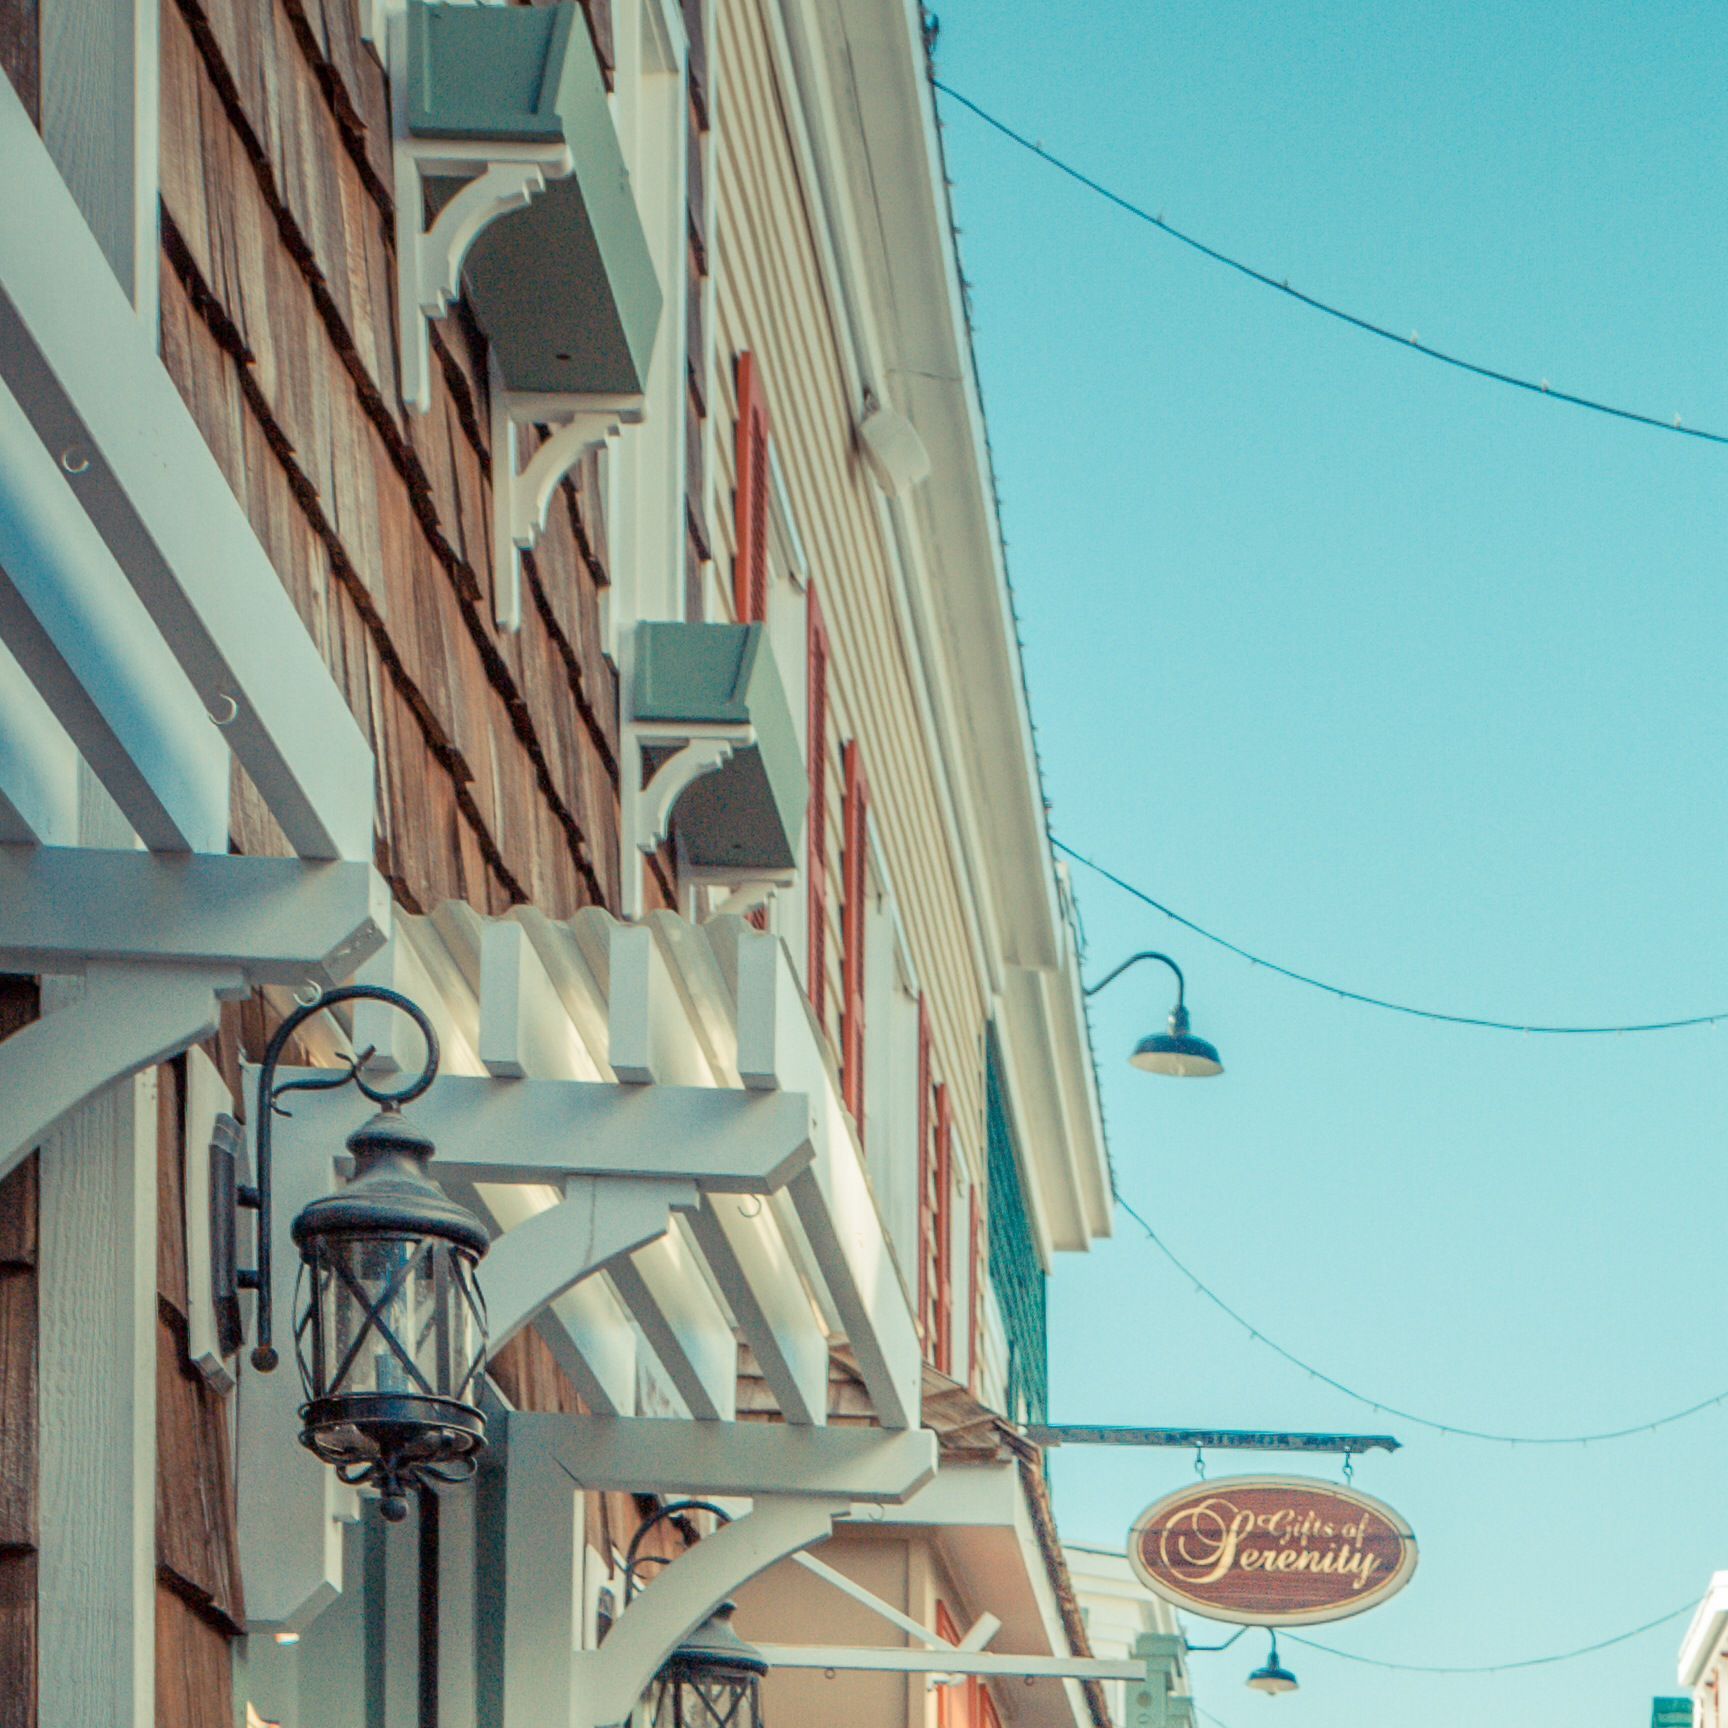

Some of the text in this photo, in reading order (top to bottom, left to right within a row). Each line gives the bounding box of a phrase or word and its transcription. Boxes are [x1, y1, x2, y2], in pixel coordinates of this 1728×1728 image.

[1160, 1499, 1380, 1589] Serenity
[1257, 1509, 1369, 1545] Gifts of
